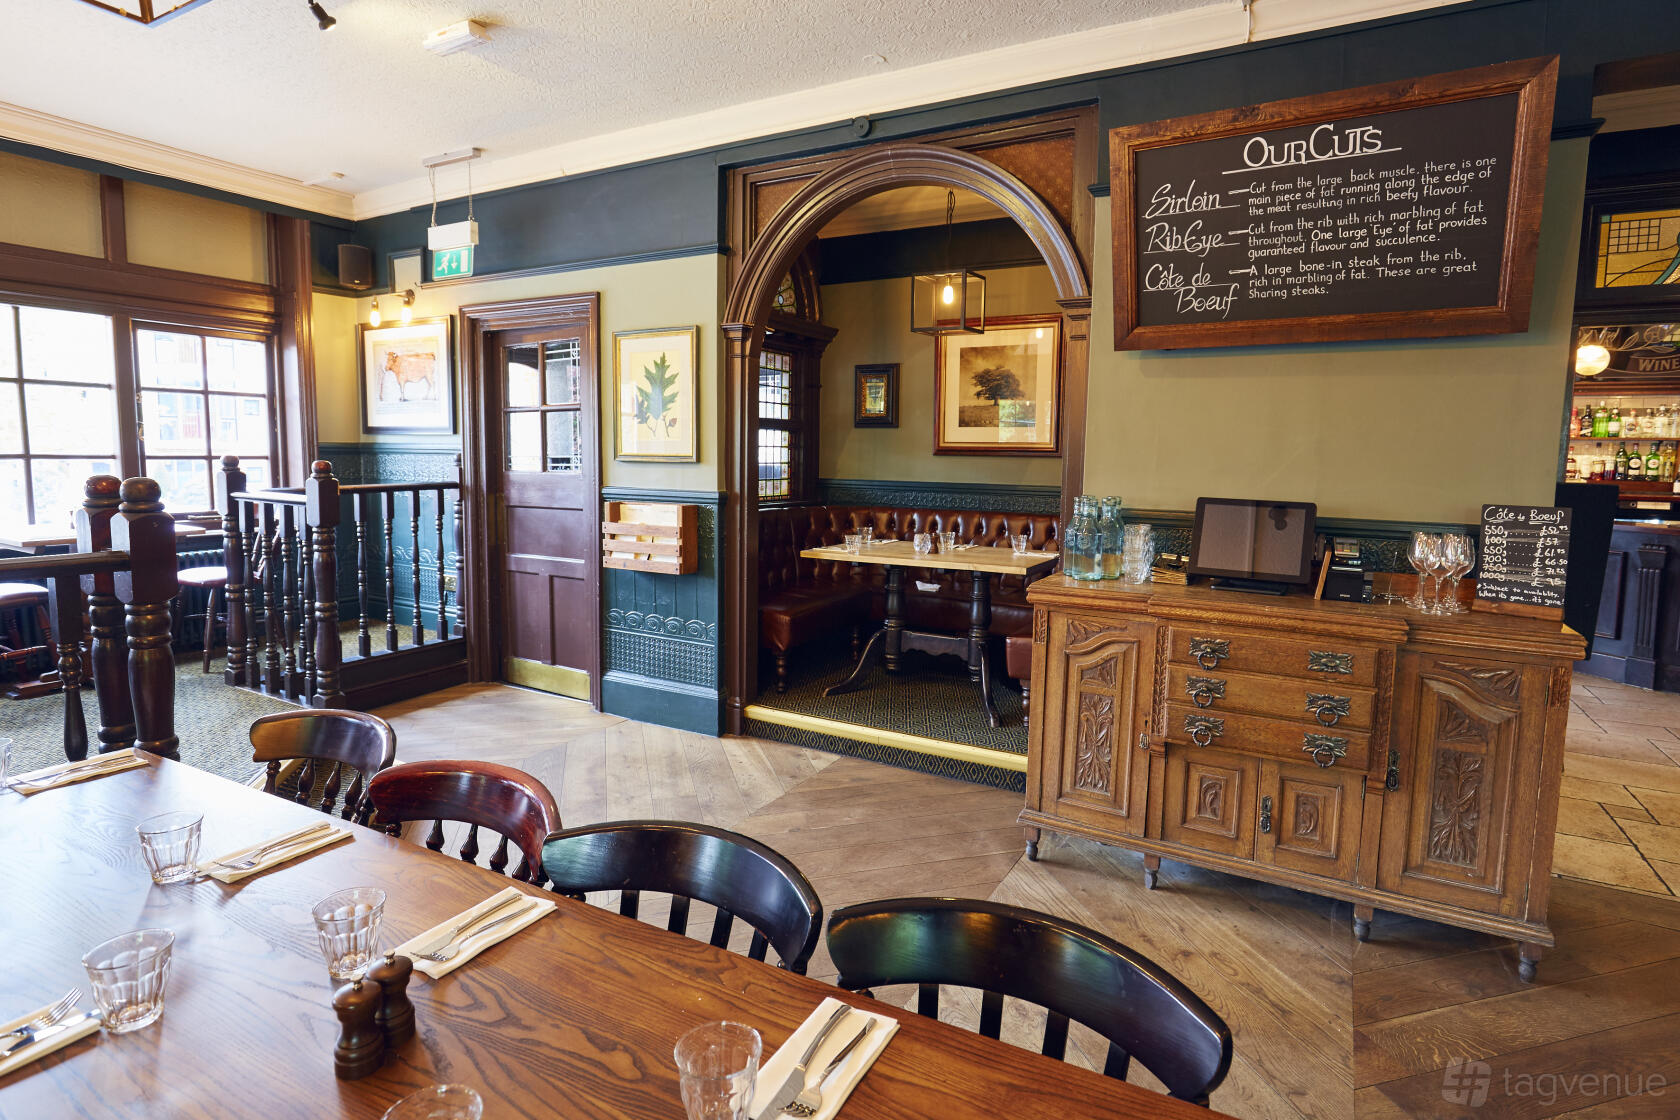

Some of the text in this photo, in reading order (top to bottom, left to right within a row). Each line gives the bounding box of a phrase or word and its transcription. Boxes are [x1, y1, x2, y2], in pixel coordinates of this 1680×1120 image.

[1249, 181, 1266, 194] Cut
[1271, 181, 1293, 192] from
[1297, 176, 1312, 188] the
[1317, 174, 1343, 187] large
[1350, 168, 1375, 182] back
[1424, 161, 1456, 173] there
[1462, 159, 1471, 168] is
[1475, 157, 1497, 167] one
[1249, 166, 1492, 206] main piece of fat running along the edge of
[1145, 179, 1222, 219] Sirloin
[1249, 185, 1473, 216] the meat resulting in rich beefy flavour.
[1248, 200, 1484, 235] Cut from the rib with rich marbling of fat
[1248, 231, 1307, 247] throughout.
[1311, 229, 1333, 241] One
[1338, 227, 1368, 240] large
[1399, 221, 1411, 234] of
[1416, 219, 1434, 231] fat
[1439, 215, 1488, 233] provides
[1248, 233, 1441, 261] guaranteed flavour and succulence.
[1249, 248, 1467, 277] A large bone-in steak from the rib.
[1145, 262, 1212, 290] Côte de
[1249, 261, 1478, 287] rich in marbling of fat. These are great
[1174, 283, 1240, 319] Boeuf
[1248, 285, 1329, 300] Sharing steaks.
[1484, 506, 1516, 521] Côte
[1530, 509, 1565, 524] Boeuf
